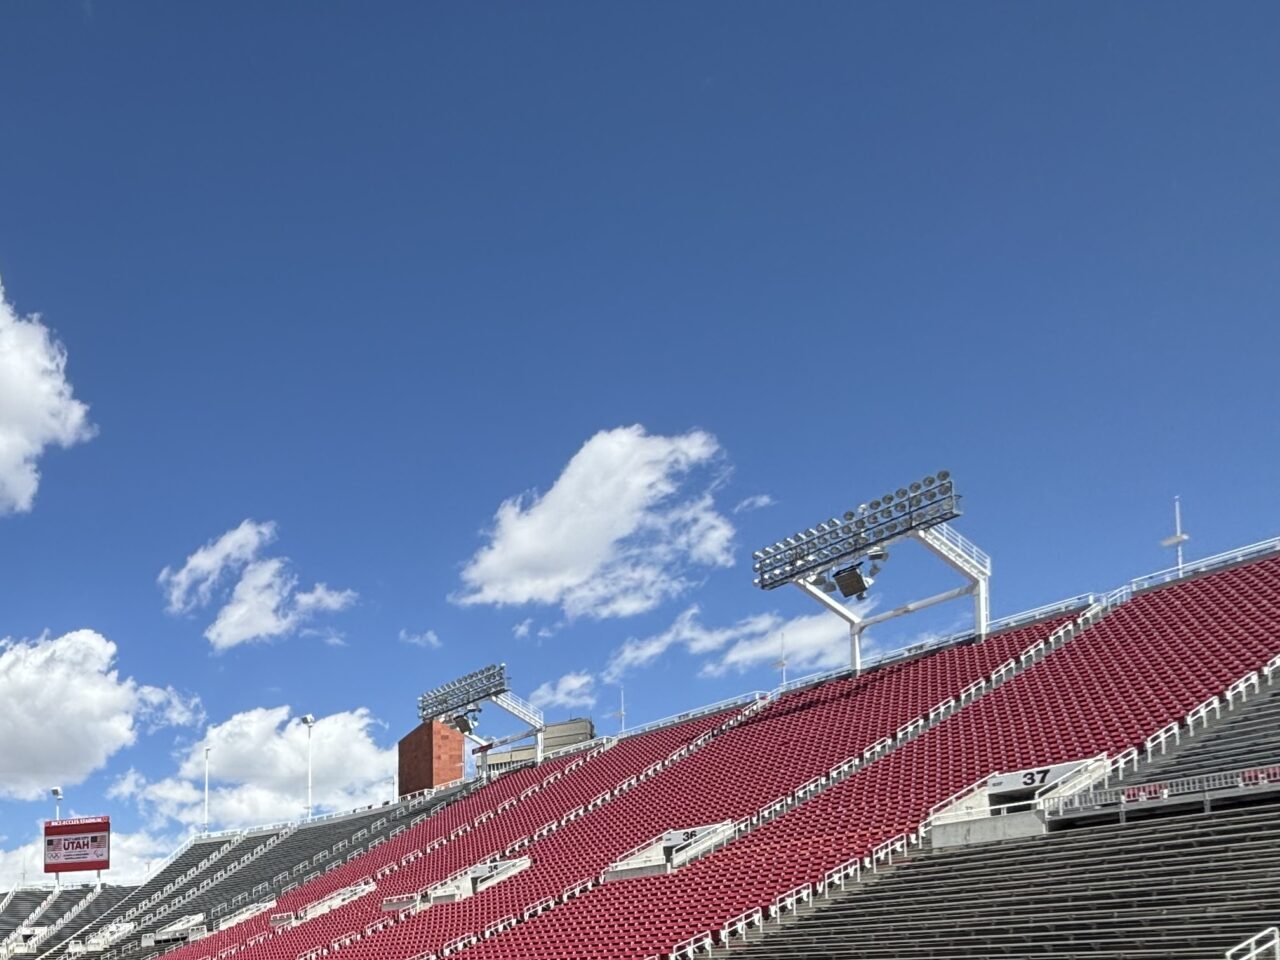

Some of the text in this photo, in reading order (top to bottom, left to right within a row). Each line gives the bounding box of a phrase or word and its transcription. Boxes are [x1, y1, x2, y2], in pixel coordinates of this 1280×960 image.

[1022, 769, 1050, 786] 37
[683, 831, 697, 842] 36
[63, 841, 89, 850] UTAH
